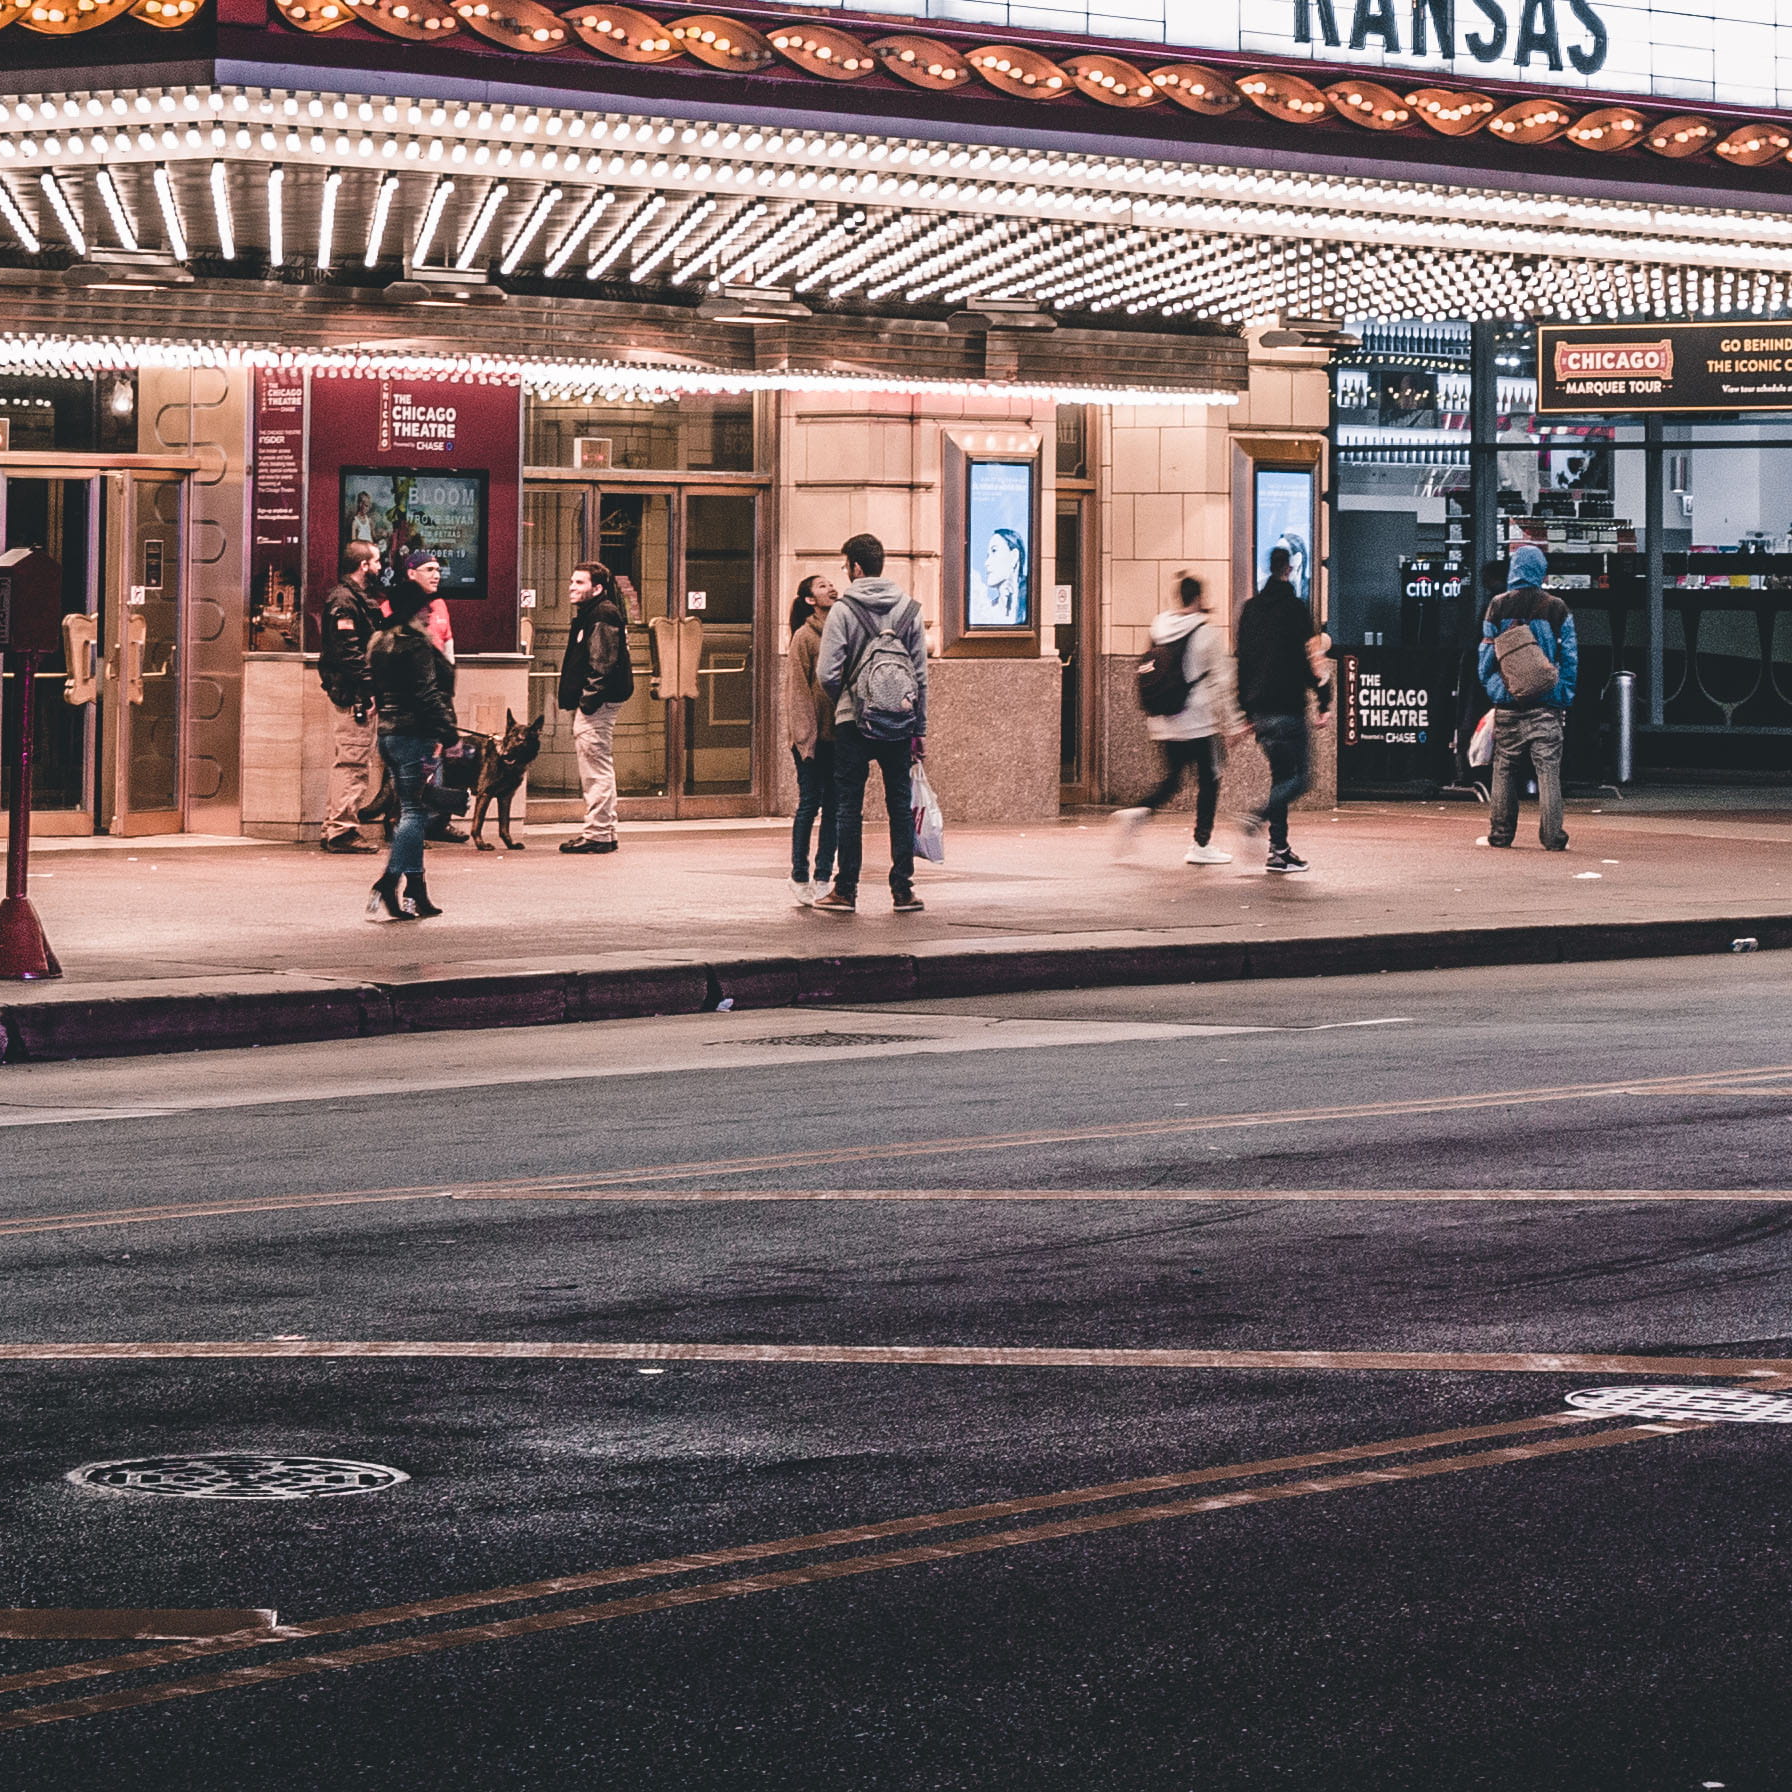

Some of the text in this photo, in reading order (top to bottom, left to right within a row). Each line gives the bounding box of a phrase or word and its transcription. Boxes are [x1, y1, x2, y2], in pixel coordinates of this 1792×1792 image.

[1721, 339, 1741, 352] GO
[1567, 351, 1660, 370] CHICAGO
[1707, 360, 1732, 373] THE
[1734, 359, 1782, 373] ICONIC
[268, 388, 302, 397] CHICAGO
[1566, 380, 1662, 396] MARQUEE TOUR
[1721, 385, 1739, 393] View
[1741, 385, 1755, 393] tour
[268, 397, 302, 405] THEATRE
[392, 394, 412, 404] THE
[381, 382, 389, 448] CHICAGO
[392, 406, 456, 422] CHICAGO
[392, 422, 456, 438] THEATRE
[416, 441, 445, 450] CHASE
[408, 487, 475, 506] BLOOM
[1411, 562, 1430, 571] ATM
[1406, 577, 1432, 598] citi
[1360, 674, 1381, 687] THE
[1348, 659, 1356, 740] CHICAGO
[1359, 689, 1429, 707] CHICAGO
[1359, 710, 1430, 727] THEATRE
[1385, 733, 1416, 743] CHASE
